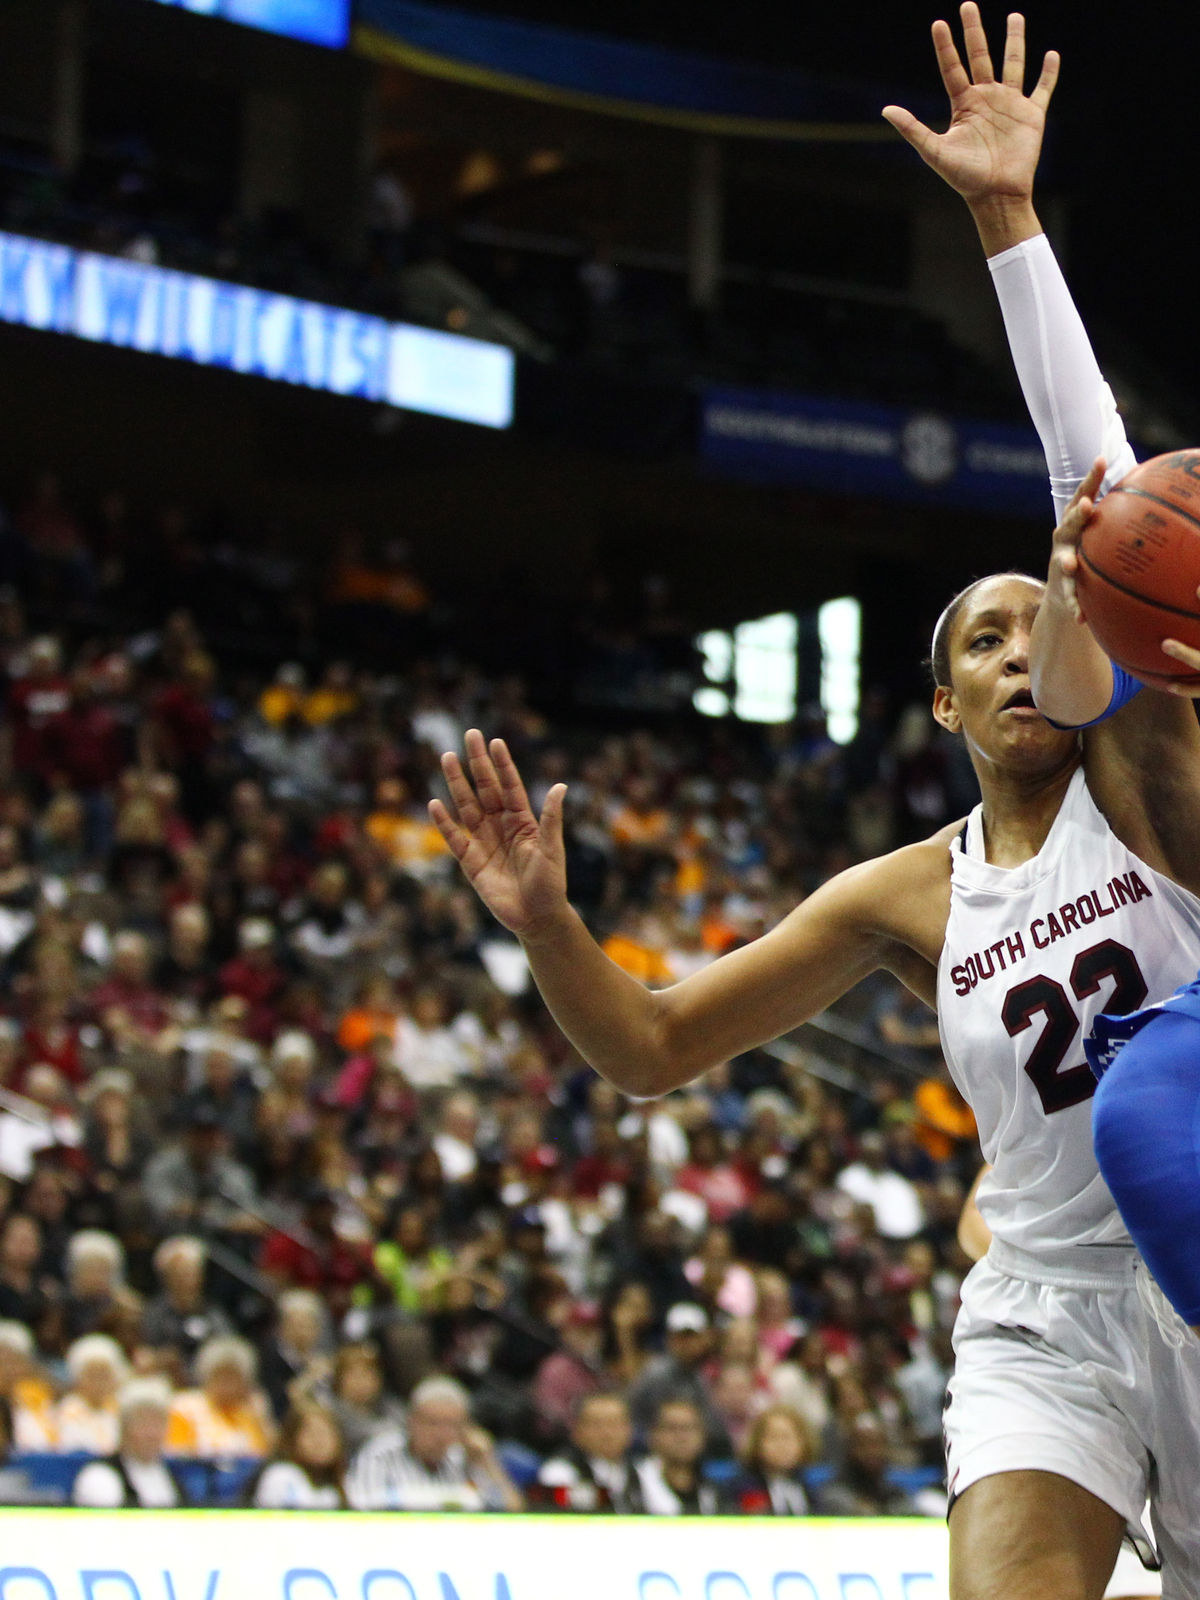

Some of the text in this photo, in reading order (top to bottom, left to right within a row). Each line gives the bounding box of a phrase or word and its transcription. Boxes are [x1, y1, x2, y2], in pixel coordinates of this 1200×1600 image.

[950, 870, 1152, 997] SOUTH CAROLINA
[1001, 938, 1149, 1116] 22
